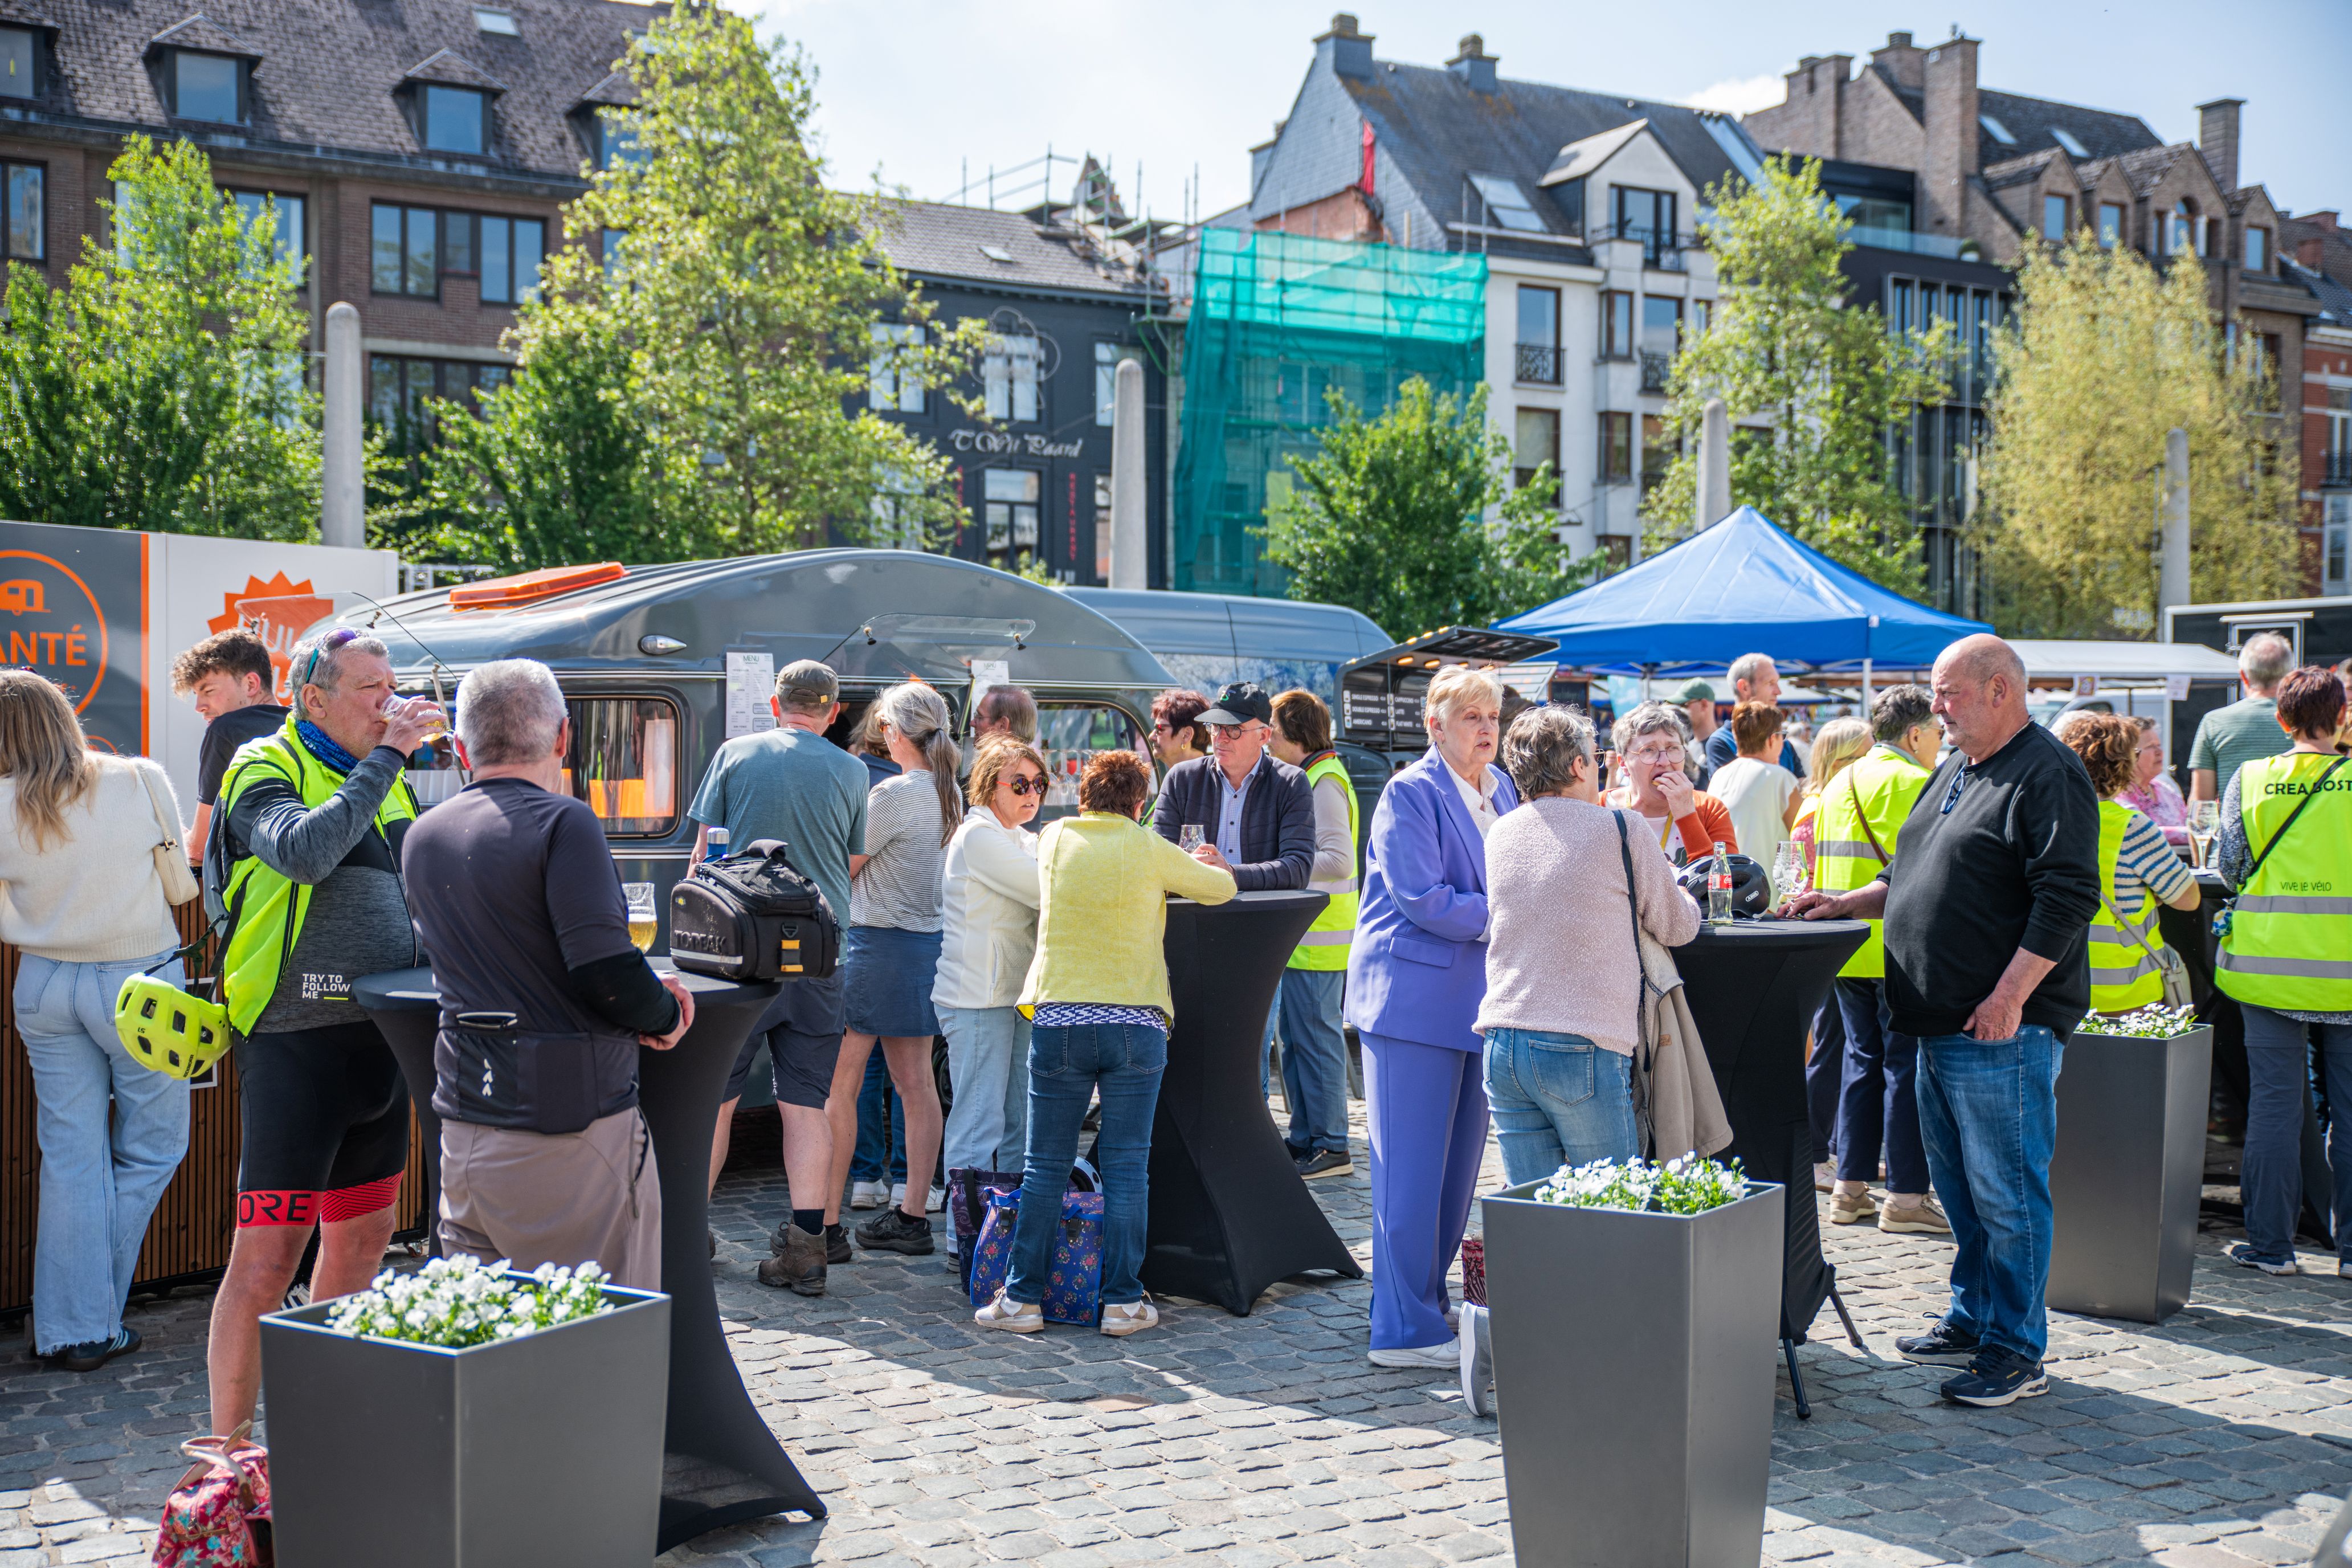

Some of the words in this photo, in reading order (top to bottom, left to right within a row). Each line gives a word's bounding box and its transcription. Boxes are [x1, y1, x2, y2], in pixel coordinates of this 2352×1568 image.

[1023, 433, 1084, 458] Paard
[0, 624, 87, 666] NTÉ
[2265, 783, 2309, 795] CREA
[674, 929, 727, 953] TOPEAK
[303, 973, 325, 983] TRY
[328, 974, 342, 983] TO
[303, 982, 351, 992] FOLLOW
[302, 990, 318, 999] ME
